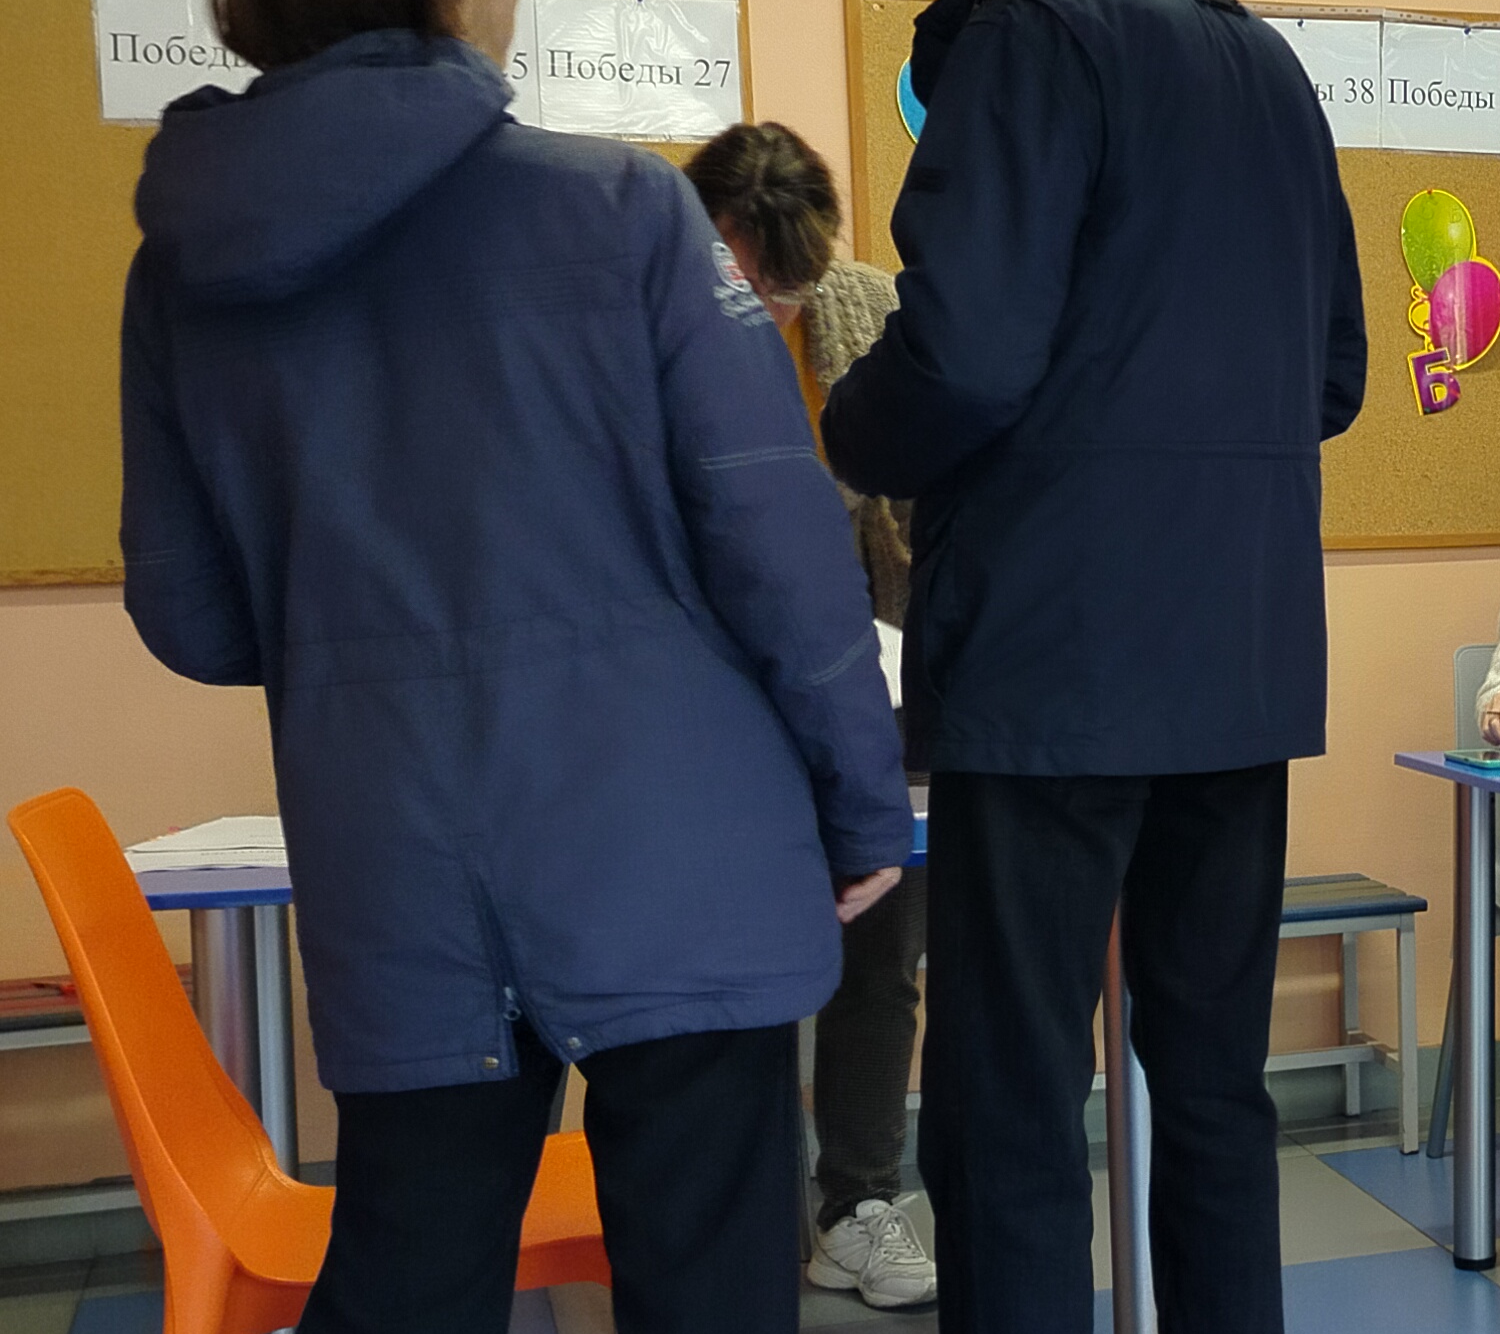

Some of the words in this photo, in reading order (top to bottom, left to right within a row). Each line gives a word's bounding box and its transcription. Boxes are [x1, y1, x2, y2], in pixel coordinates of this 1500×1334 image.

[501, 52, 528, 79] 5
[546, 49, 682, 88] Победы
[693, 59, 731, 88] 27
[1343, 77, 1374, 104] 38
[1387, 78, 1496, 110] Победы
[1408, 347, 1461, 415] Б
